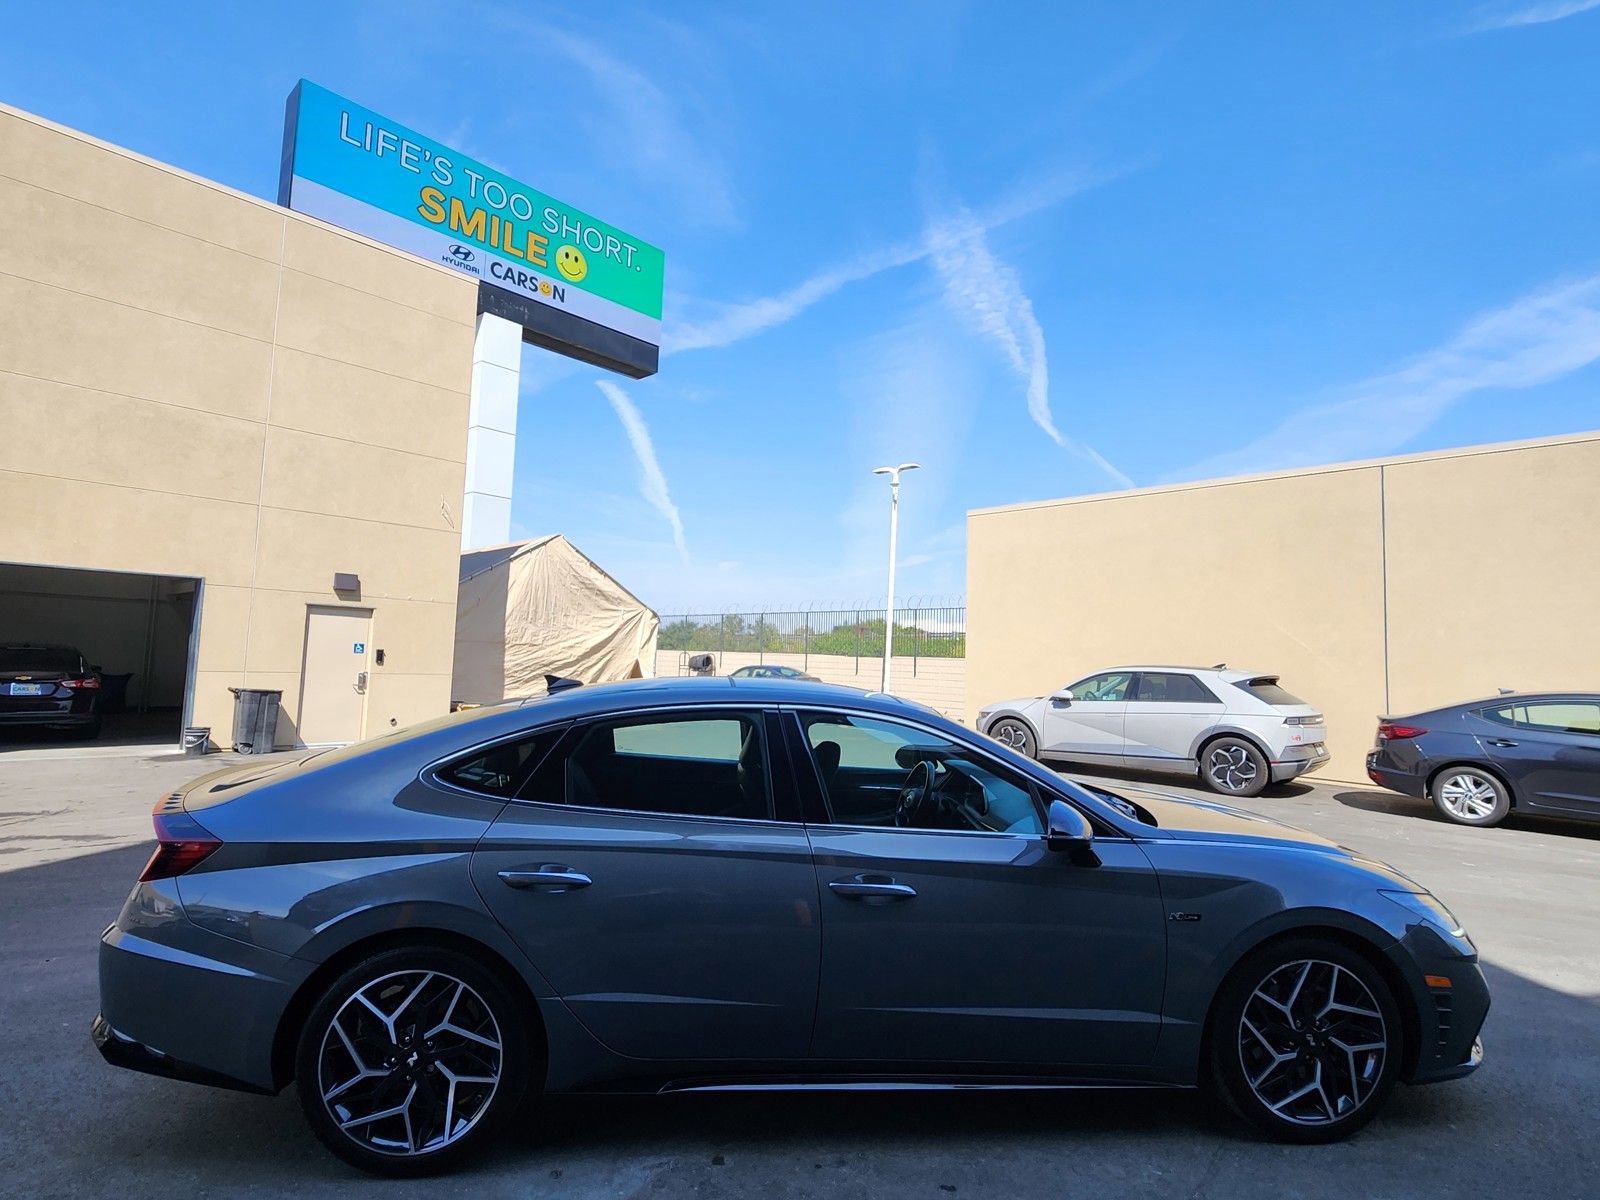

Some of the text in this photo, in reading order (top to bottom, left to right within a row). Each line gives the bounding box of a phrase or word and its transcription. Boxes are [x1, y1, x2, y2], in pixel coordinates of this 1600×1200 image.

[339, 110, 642, 273] LIFE'S TOO SHORT.
[416, 185, 549, 269] SMILE
[441, 255, 480, 275] HYUNDAI
